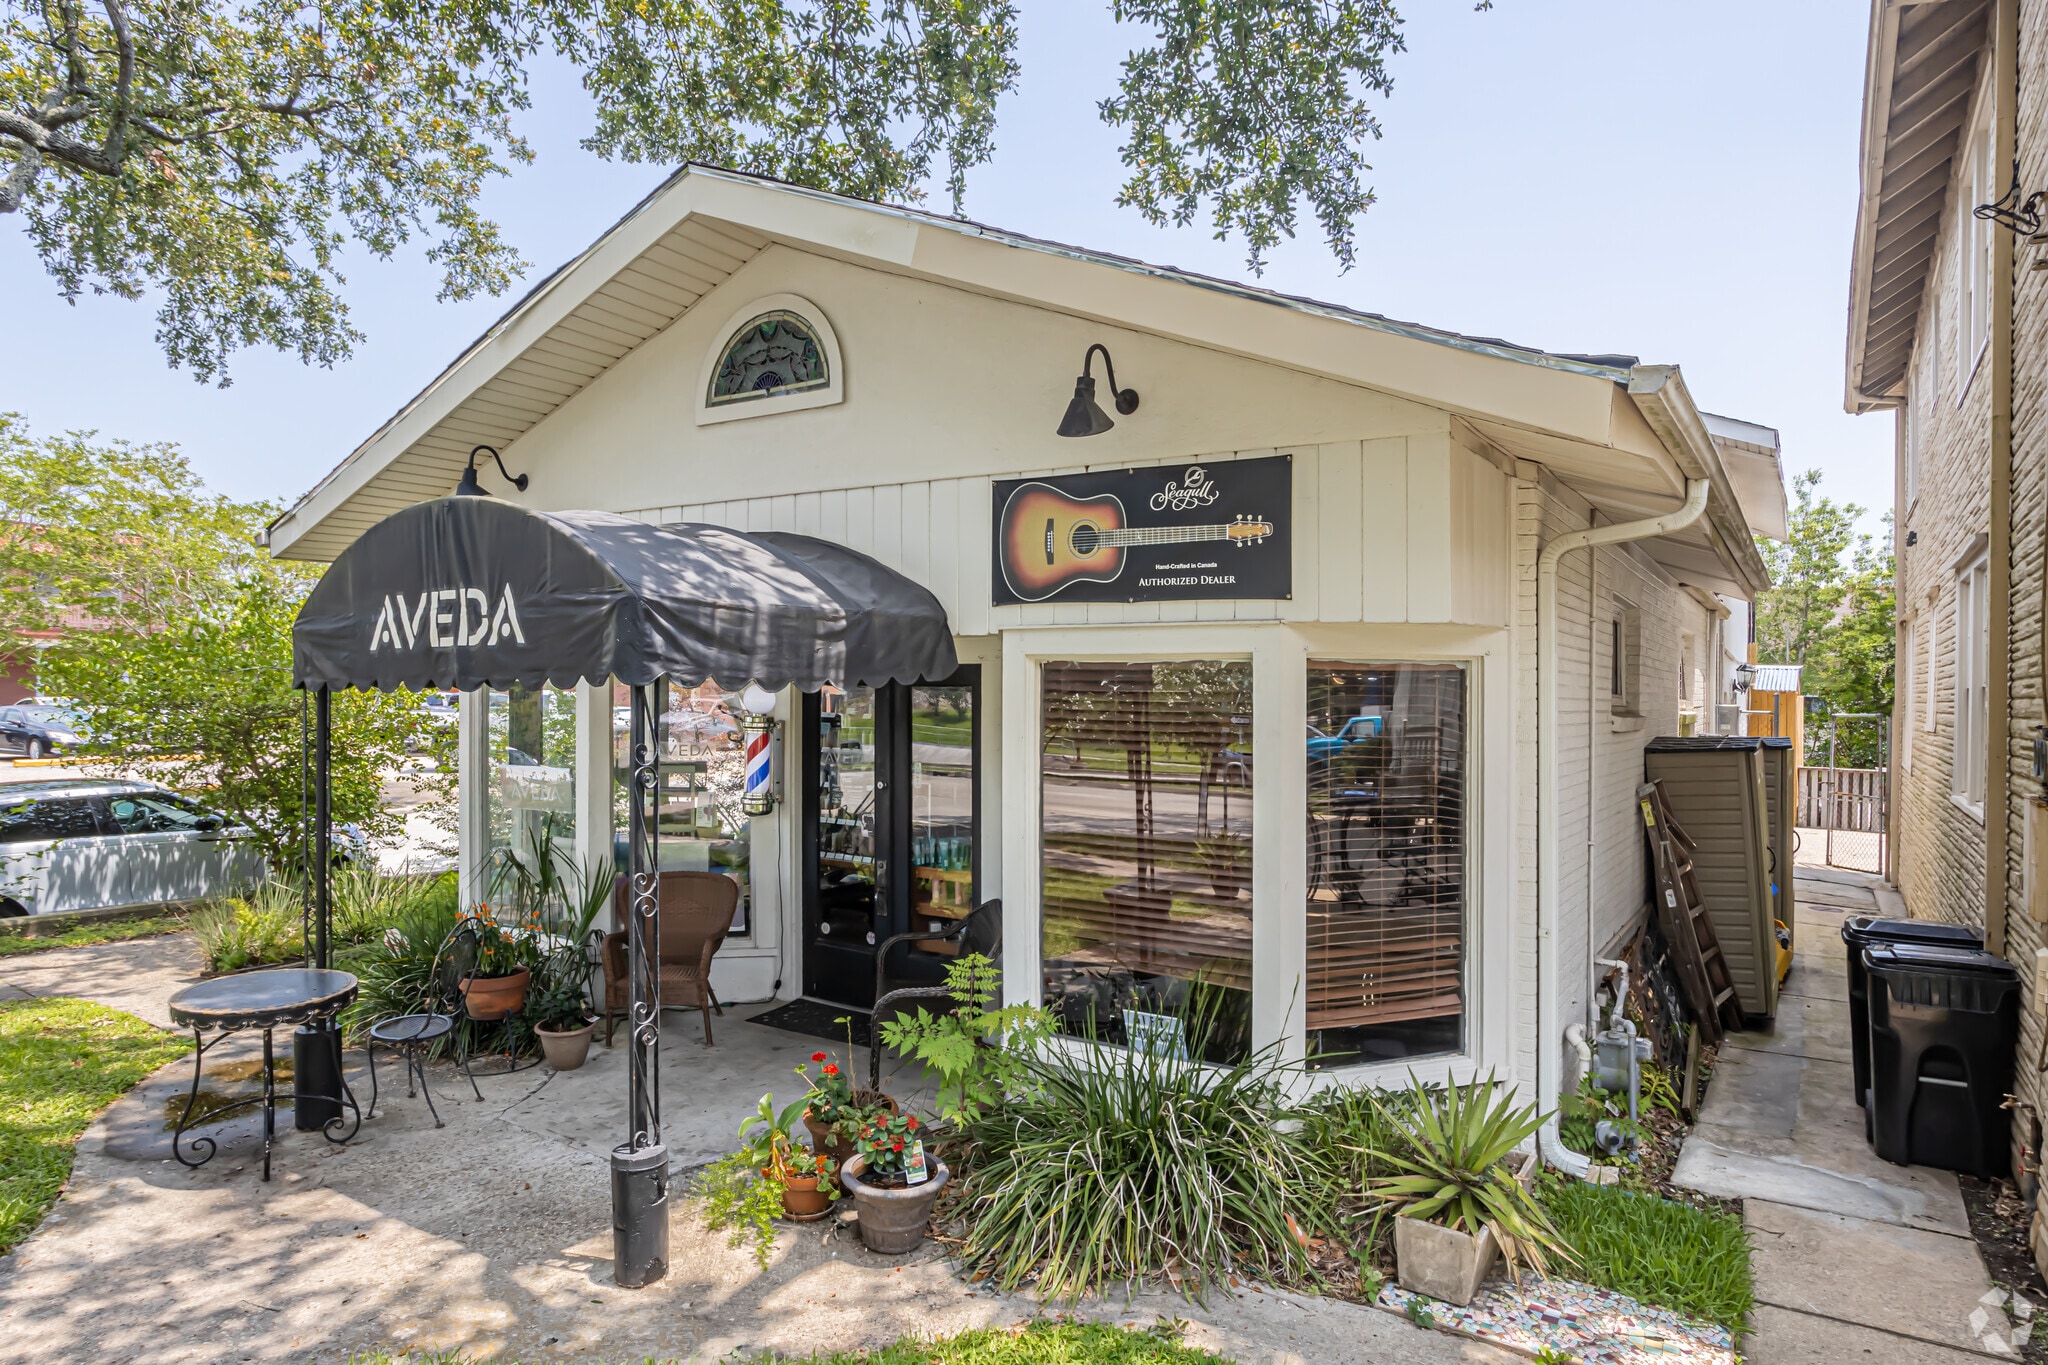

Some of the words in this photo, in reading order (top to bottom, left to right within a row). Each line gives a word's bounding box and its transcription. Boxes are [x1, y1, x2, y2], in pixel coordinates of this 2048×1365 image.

[1150, 480, 1219, 511] Seagull
[1138, 577, 1198, 587] AUTHORIZED
[1200, 575, 1236, 585] DEALER
[370, 582, 525, 651] AVEDA
